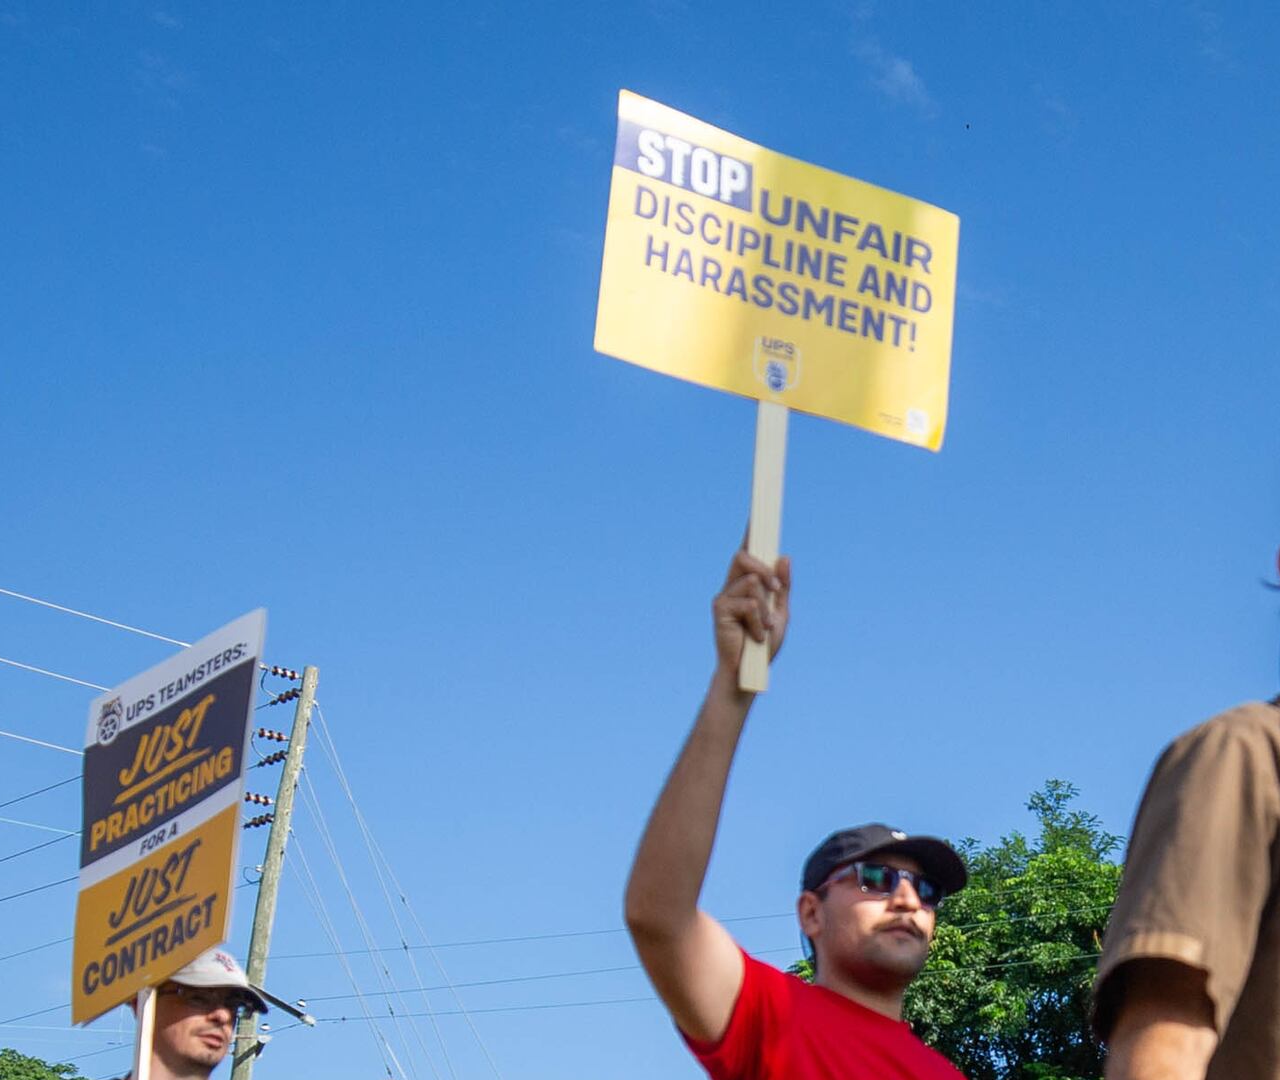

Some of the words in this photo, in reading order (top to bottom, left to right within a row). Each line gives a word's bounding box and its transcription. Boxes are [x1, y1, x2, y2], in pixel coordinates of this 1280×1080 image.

[637, 127, 748, 202] STOP
[759, 188, 933, 273] UNFAIR
[633, 185, 848, 287] DISCIPLINE
[857, 263, 932, 314] AND
[644, 233, 918, 352] HARASSMENT!
[762, 336, 795, 355] UPS
[126, 694, 155, 722] UPS
[158, 643, 248, 705] TEAMSTERS:
[119, 694, 217, 787] JUST
[89, 746, 234, 852] PRACTICING
[139, 833, 166, 855] FOR
[168, 822, 179, 837] A
[108, 838, 202, 929] JUST
[82, 893, 218, 995] CONTRACT
